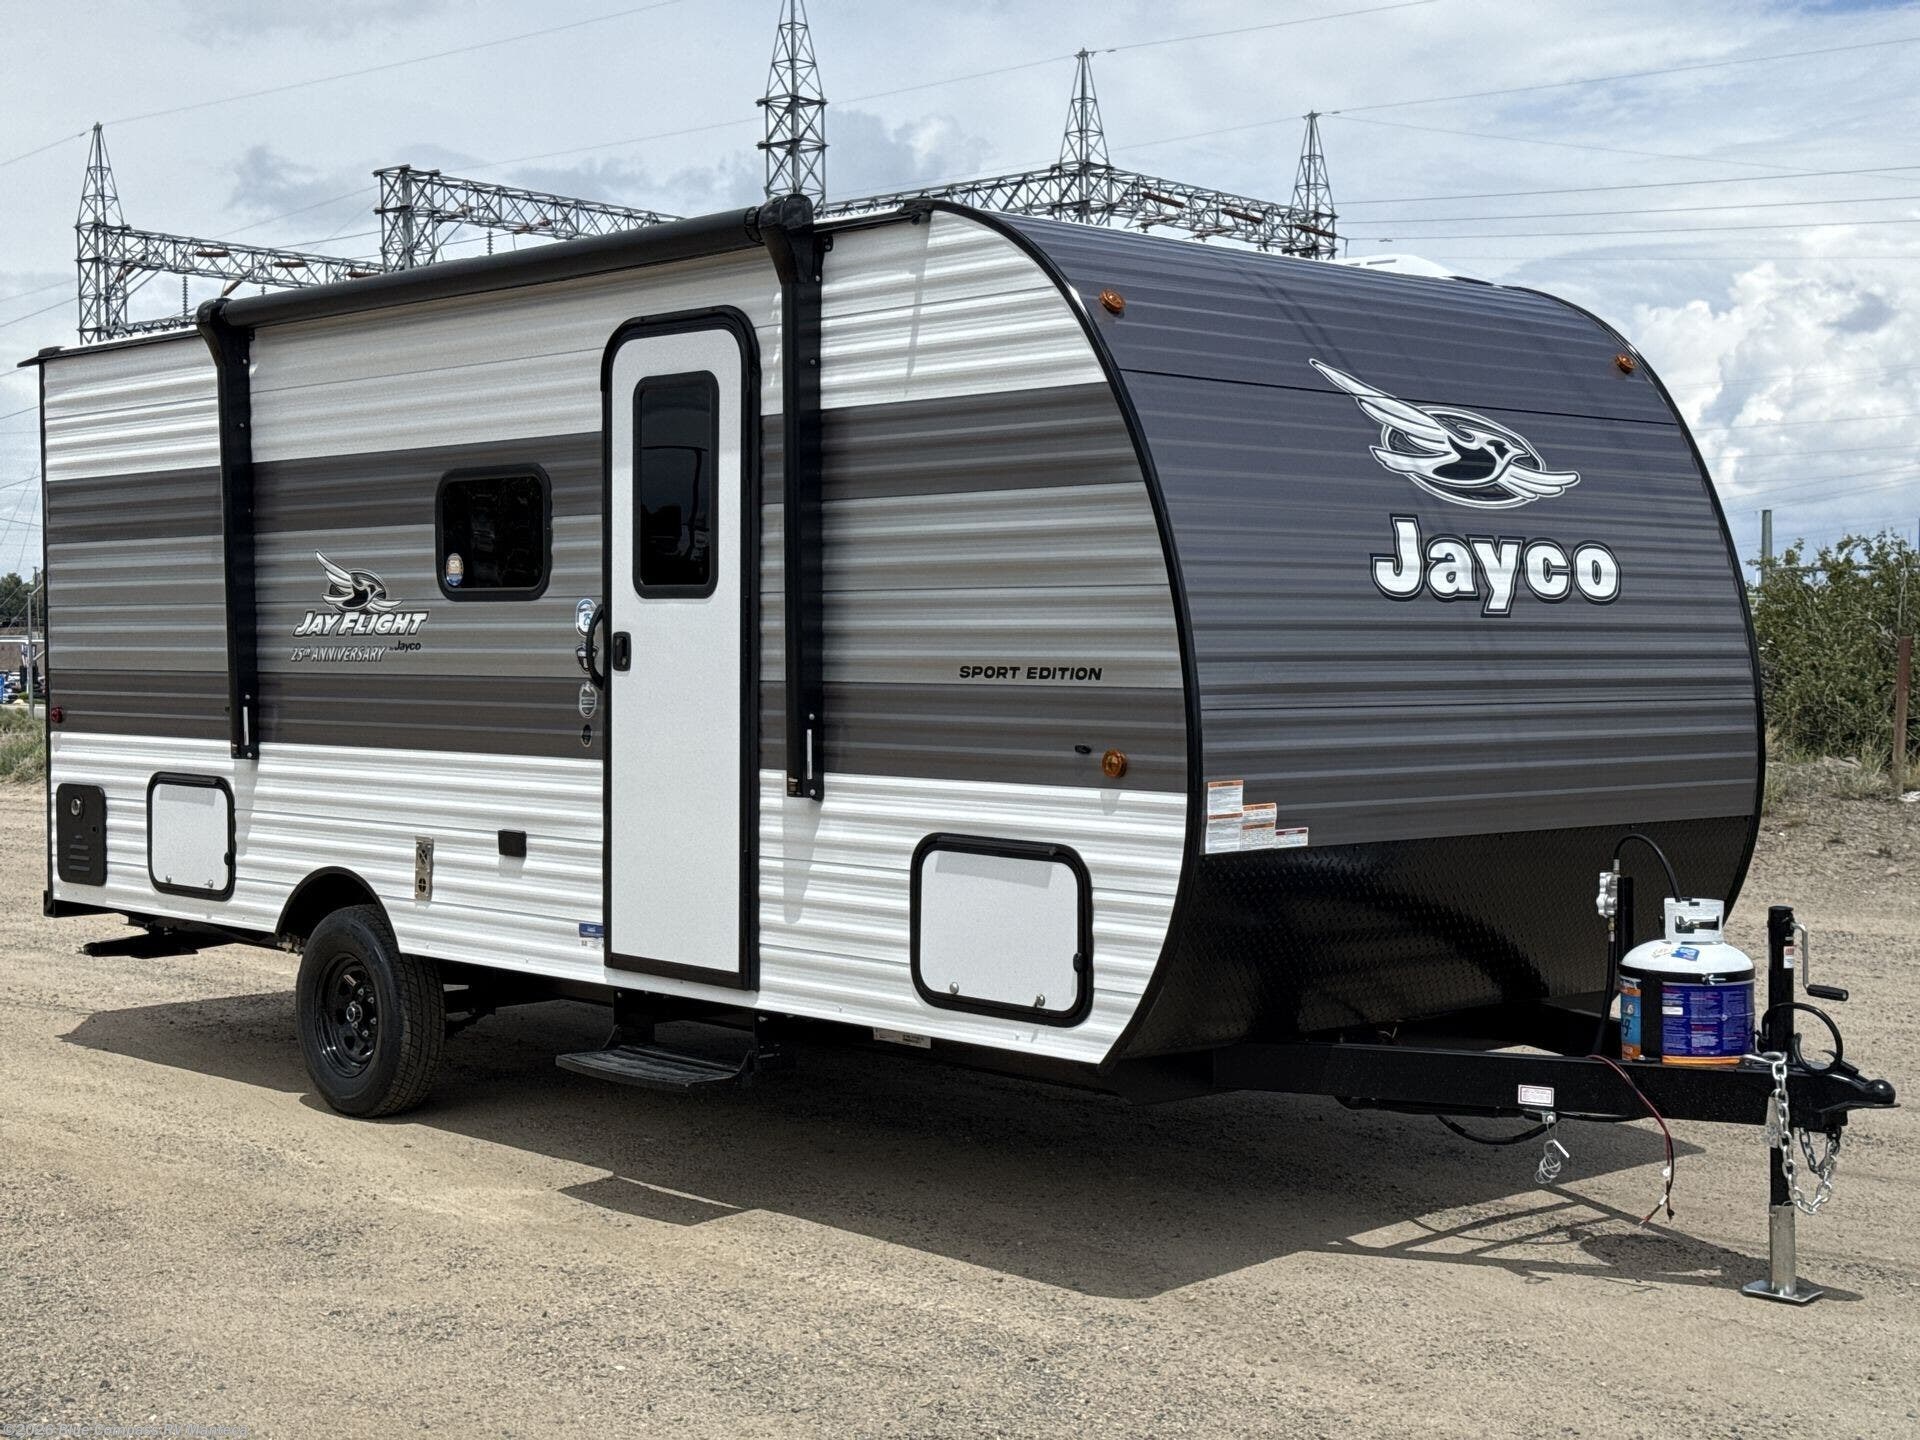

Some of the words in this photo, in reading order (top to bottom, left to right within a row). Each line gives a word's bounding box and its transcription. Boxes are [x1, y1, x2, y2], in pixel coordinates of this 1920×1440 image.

[1370, 513, 1622, 617] Jayco
[293, 611, 340, 637] JAY
[338, 611, 429, 636] FLIGHT
[311, 646, 386, 663] ANNIVERSARY
[394, 640, 422, 653] Jayco
[959, 665, 1021, 679] SPORT
[1026, 667, 1103, 681] EDITION
